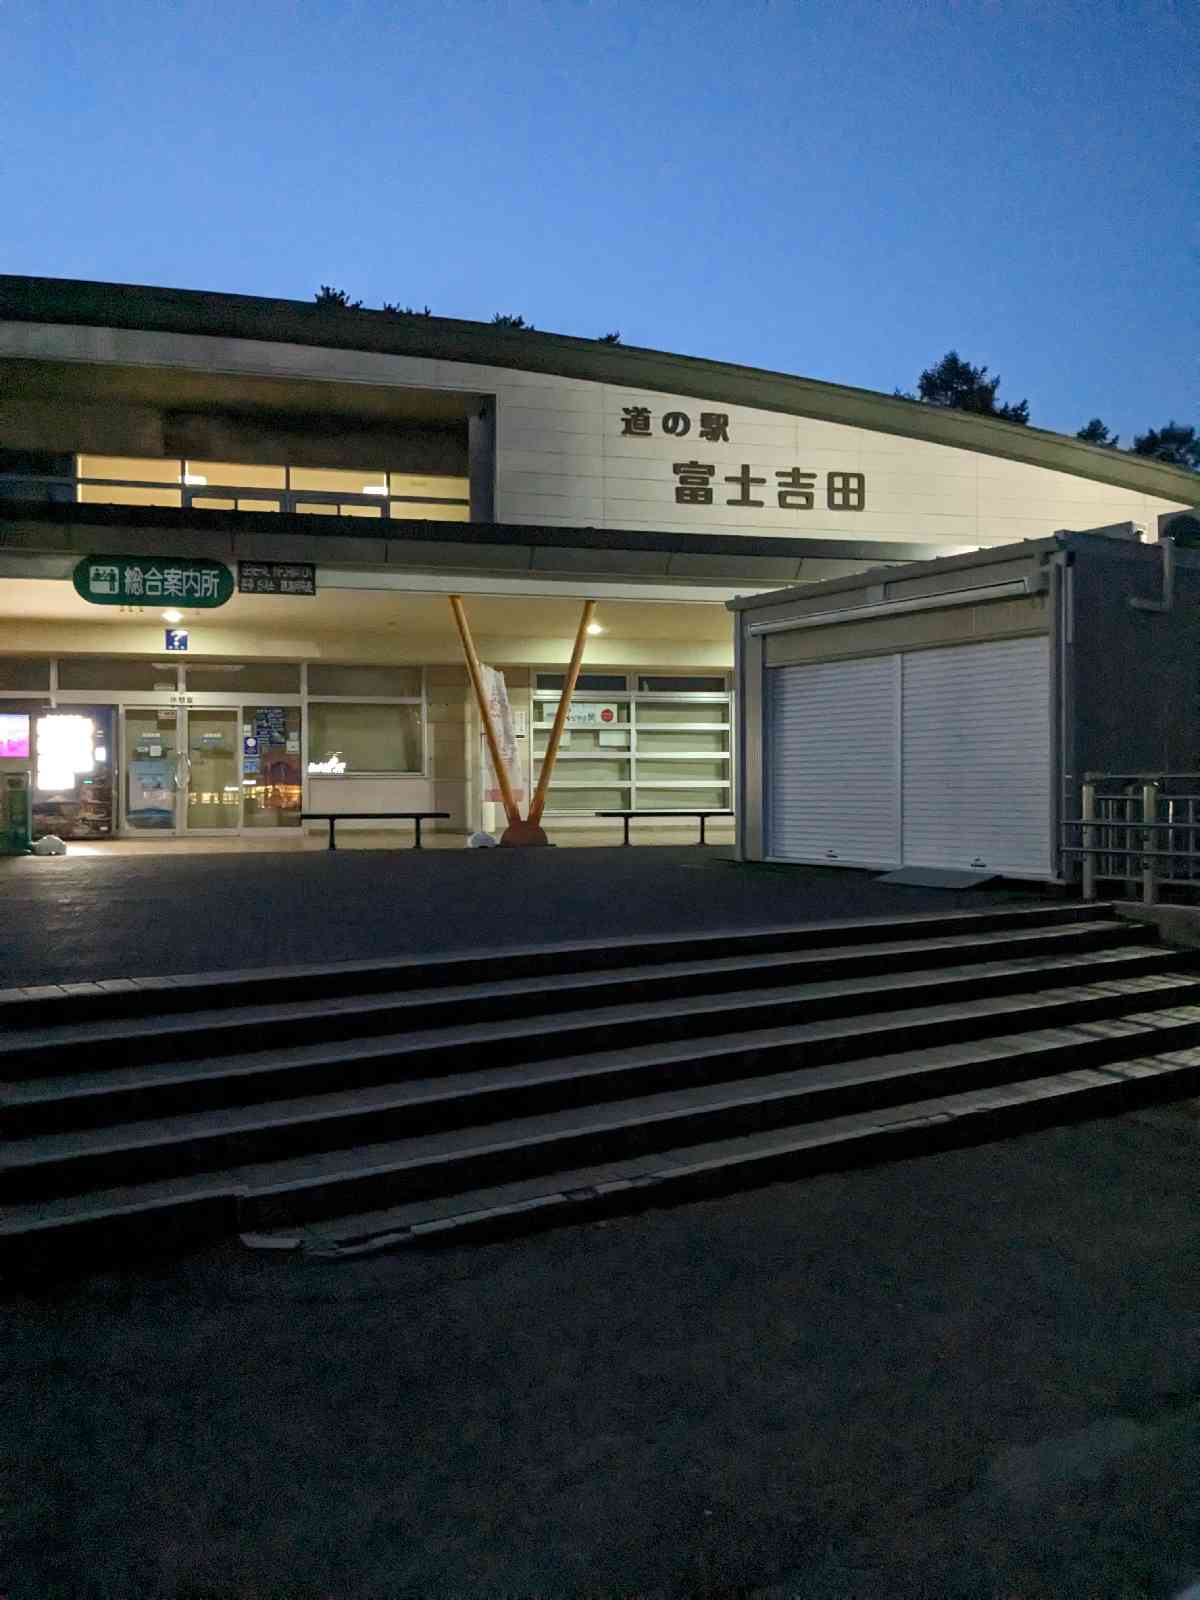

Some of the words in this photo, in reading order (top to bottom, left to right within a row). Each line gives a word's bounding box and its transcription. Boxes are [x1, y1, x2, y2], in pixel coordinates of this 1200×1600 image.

[621, 406, 730, 442] 道の駅
[673, 461, 866, 510] 富士吉田
[124, 567, 220, 598] 総合案内所
